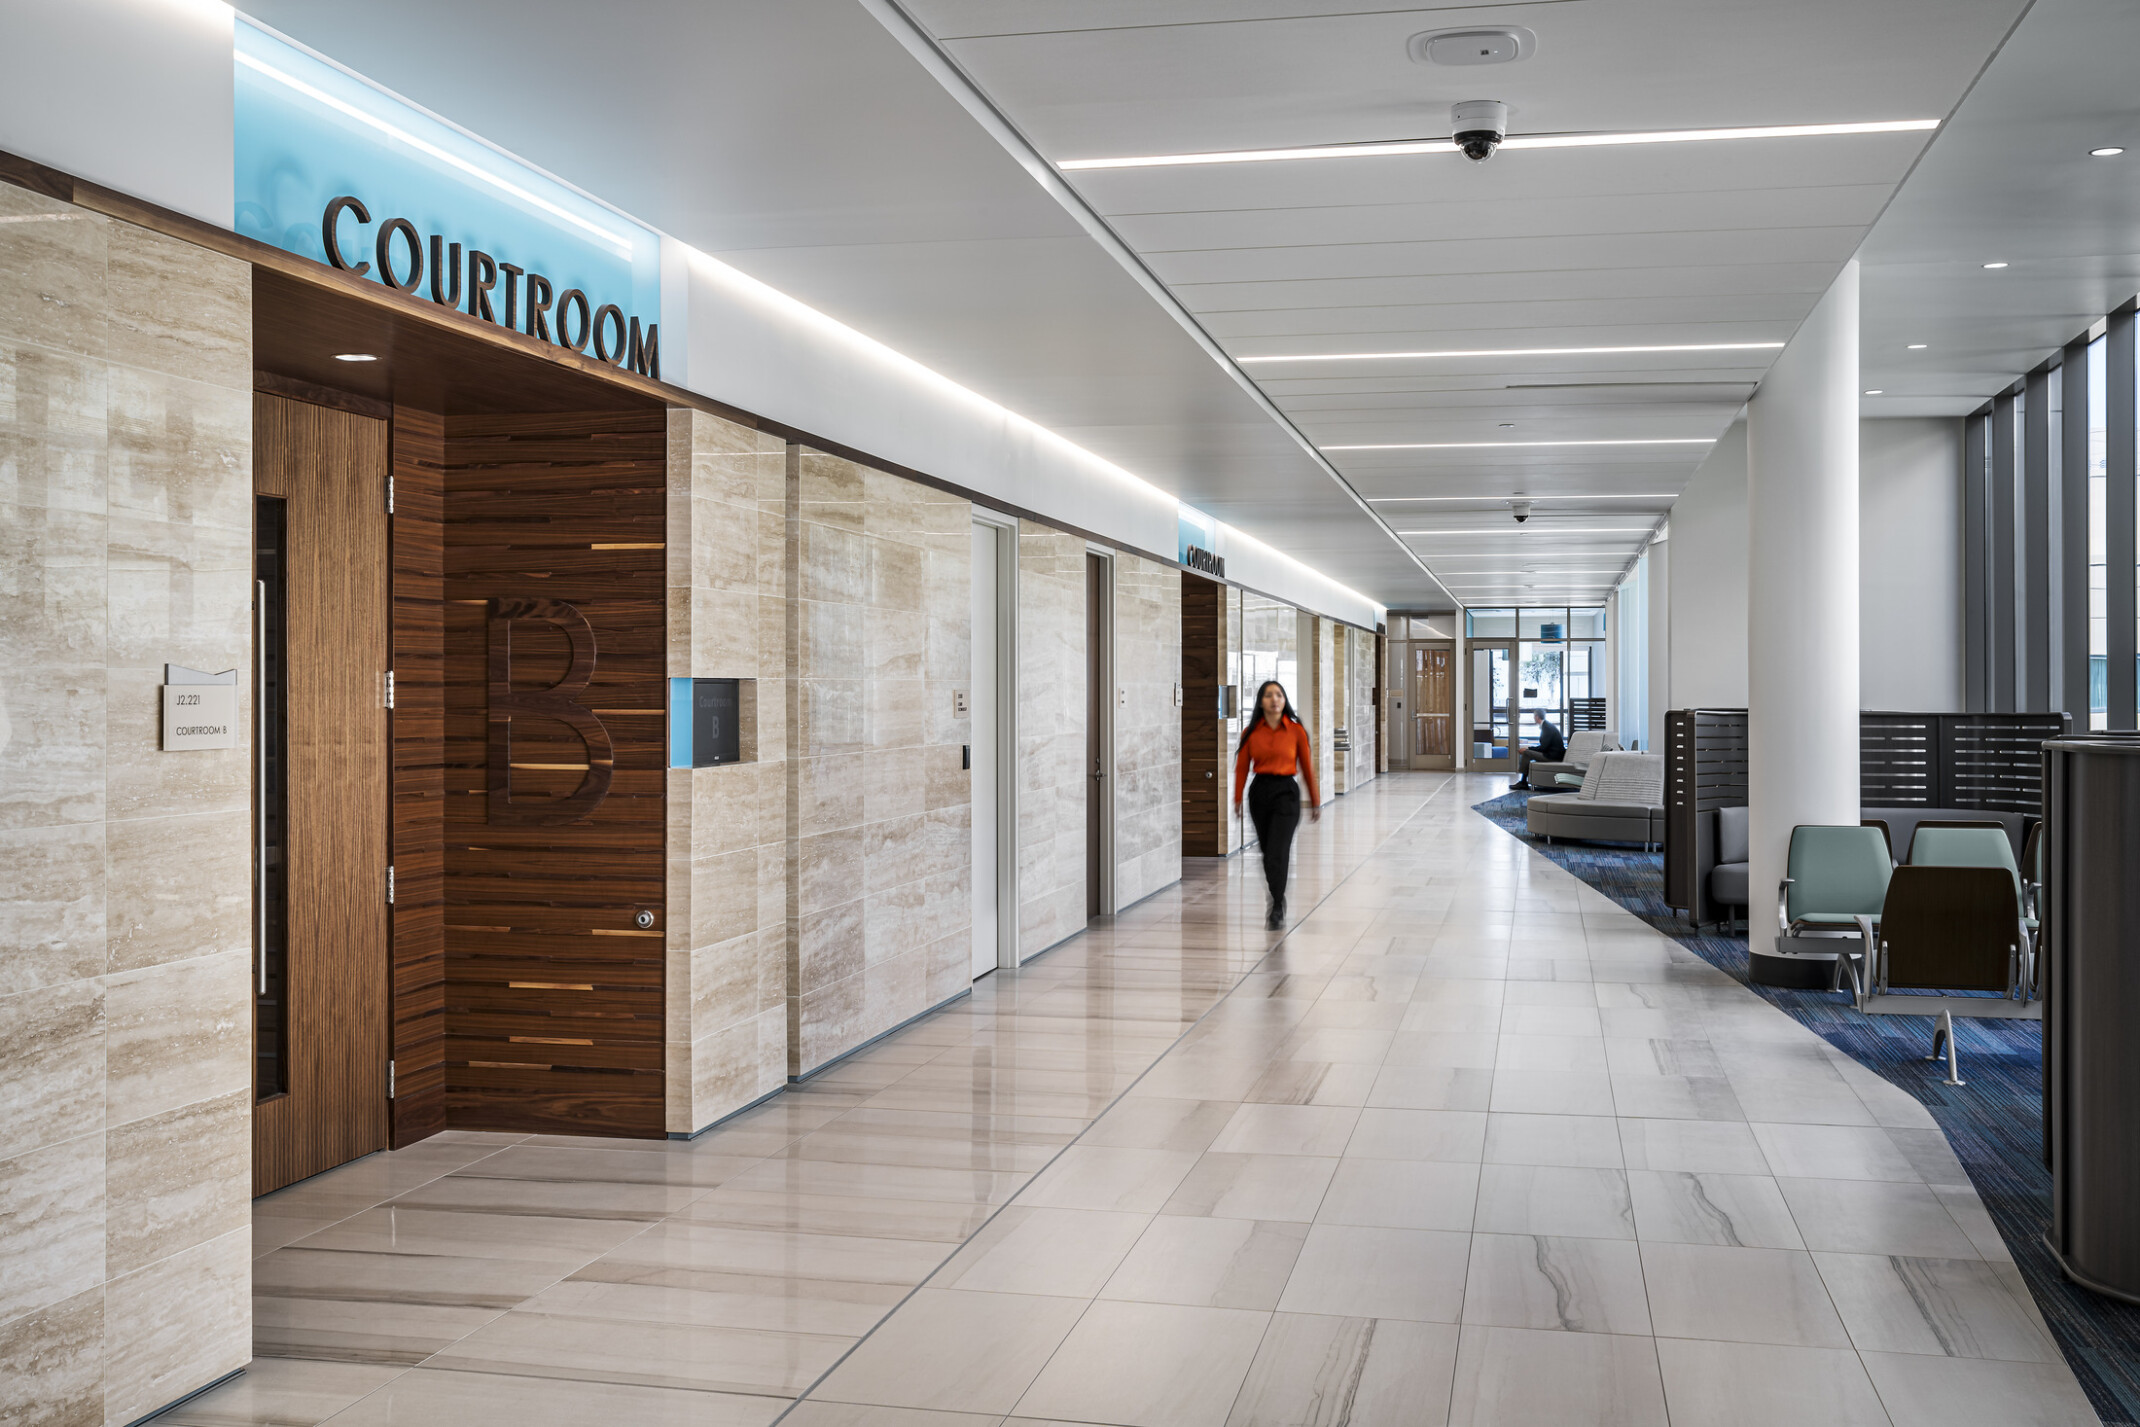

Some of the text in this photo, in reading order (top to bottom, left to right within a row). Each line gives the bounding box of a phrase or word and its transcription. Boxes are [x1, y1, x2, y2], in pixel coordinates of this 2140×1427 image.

[322, 196, 660, 379] COURTROOM
[176, 725, 228, 736] COURTROOM B
[488, 599, 613, 825] B
[712, 716, 719, 739] B
